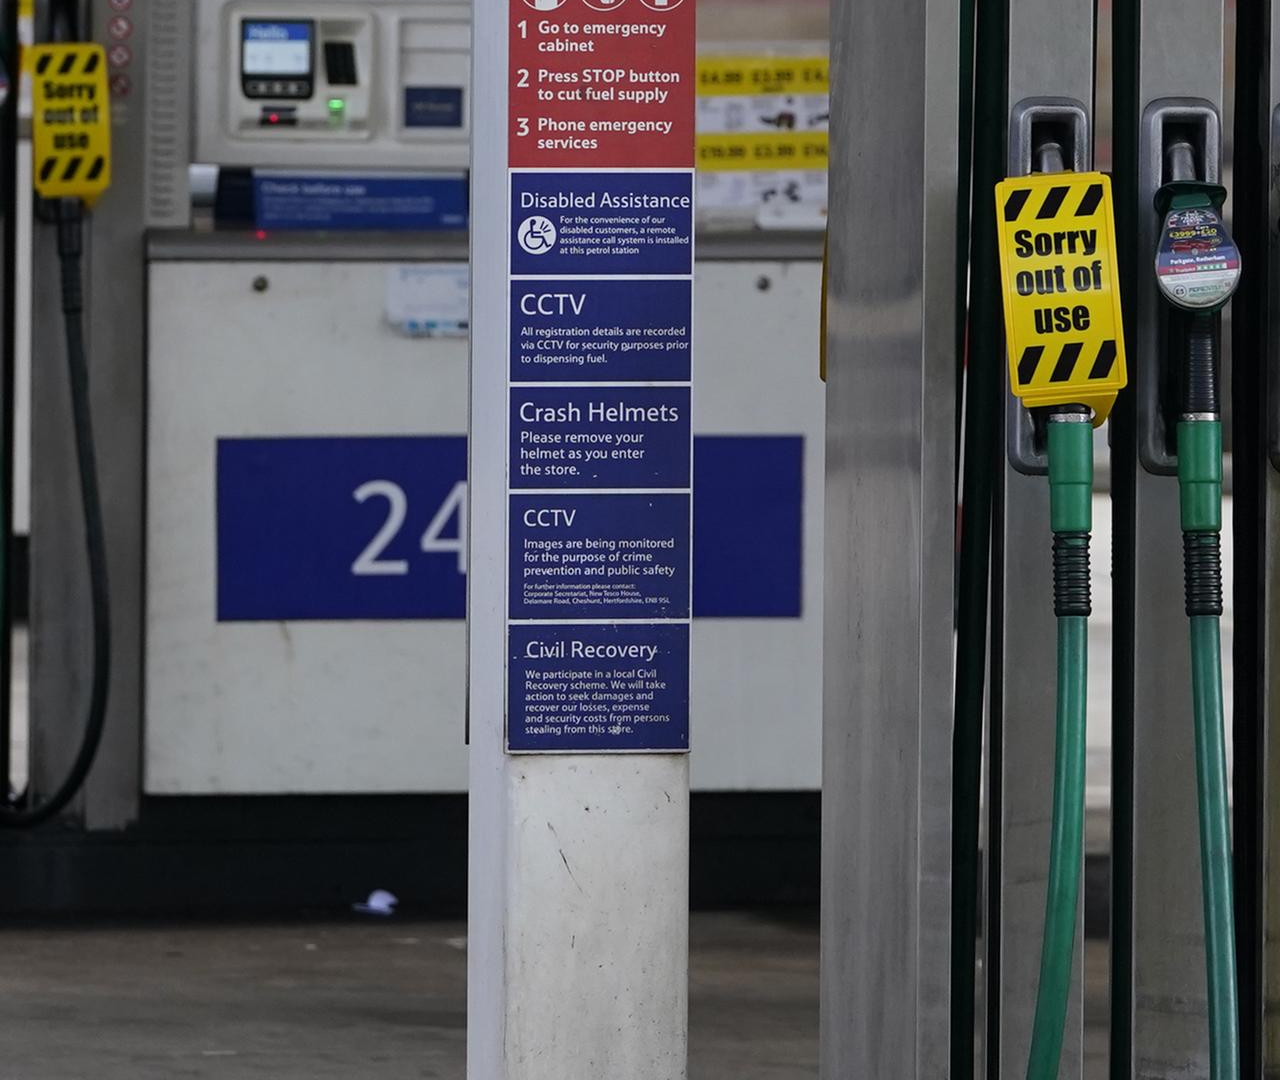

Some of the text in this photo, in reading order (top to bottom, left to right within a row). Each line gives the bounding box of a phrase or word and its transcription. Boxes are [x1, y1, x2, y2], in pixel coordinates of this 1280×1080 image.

[517, 20, 666, 39] 1 Go to emergency
[538, 38, 594, 52] cabinet
[517, 69, 679, 87] 2 Press STOP button
[43, 81, 96, 101] Sorry
[538, 87, 668, 103] to cut fuel supply
[44, 105, 99, 124] out of
[517, 118, 672, 136] 3 Phone emergency
[53, 132, 89, 150] use
[537, 136, 597, 149] services
[521, 192, 690, 208] Disabled Assistance
[1015, 227, 1099, 260] Sorry
[1016, 260, 1102, 296] out of
[521, 294, 586, 315] CCTV
[1034, 305, 1091, 335] use
[520, 402, 678, 422] Crash Helmets
[524, 509, 576, 527] CCTV
[351, 480, 467, 576] 24
[526, 641, 658, 662] Civil Recovery
